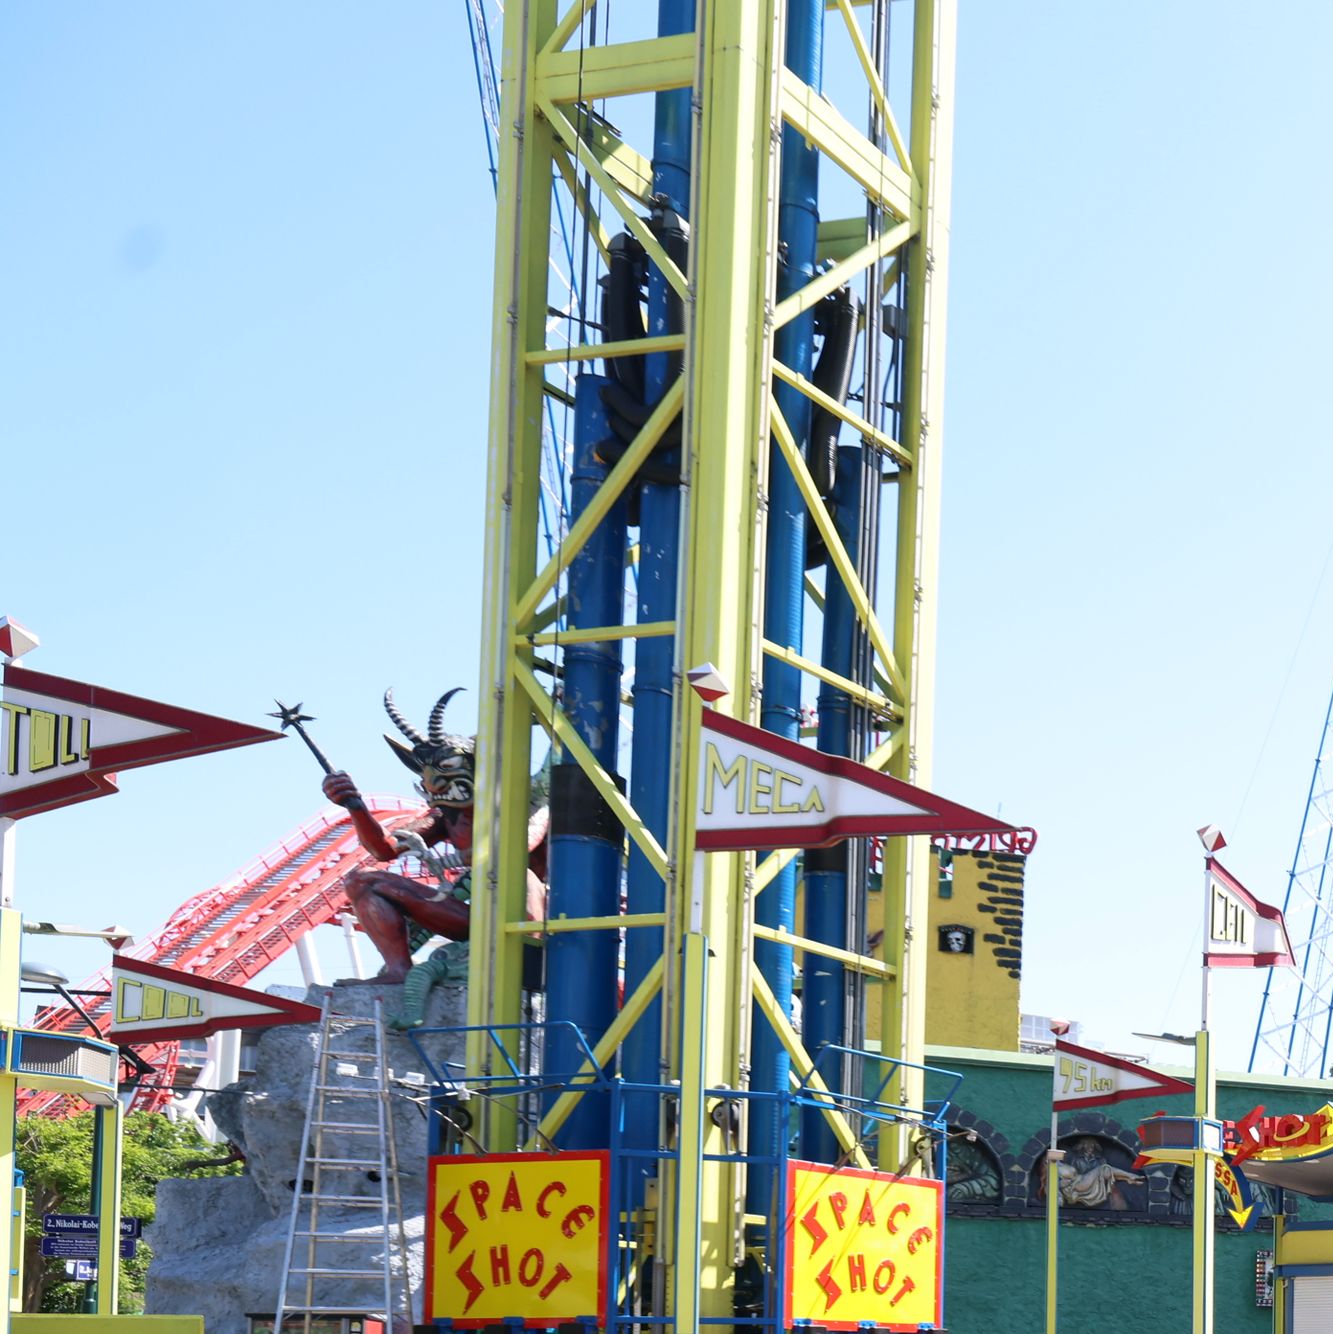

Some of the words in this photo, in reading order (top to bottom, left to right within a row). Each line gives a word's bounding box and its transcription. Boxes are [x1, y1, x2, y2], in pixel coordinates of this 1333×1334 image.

[703, 741, 825, 815] MEGA
[116, 976, 204, 1025] COOL
[1231, 1105, 1332, 1167] SHOT
[440, 1169, 595, 1254] SPACE
[1215, 1162, 1238, 1196] SSA
[800, 1188, 933, 1259] SPACE
[456, 1244, 573, 1315] SHOT
[816, 1253, 916, 1315] SHOT
